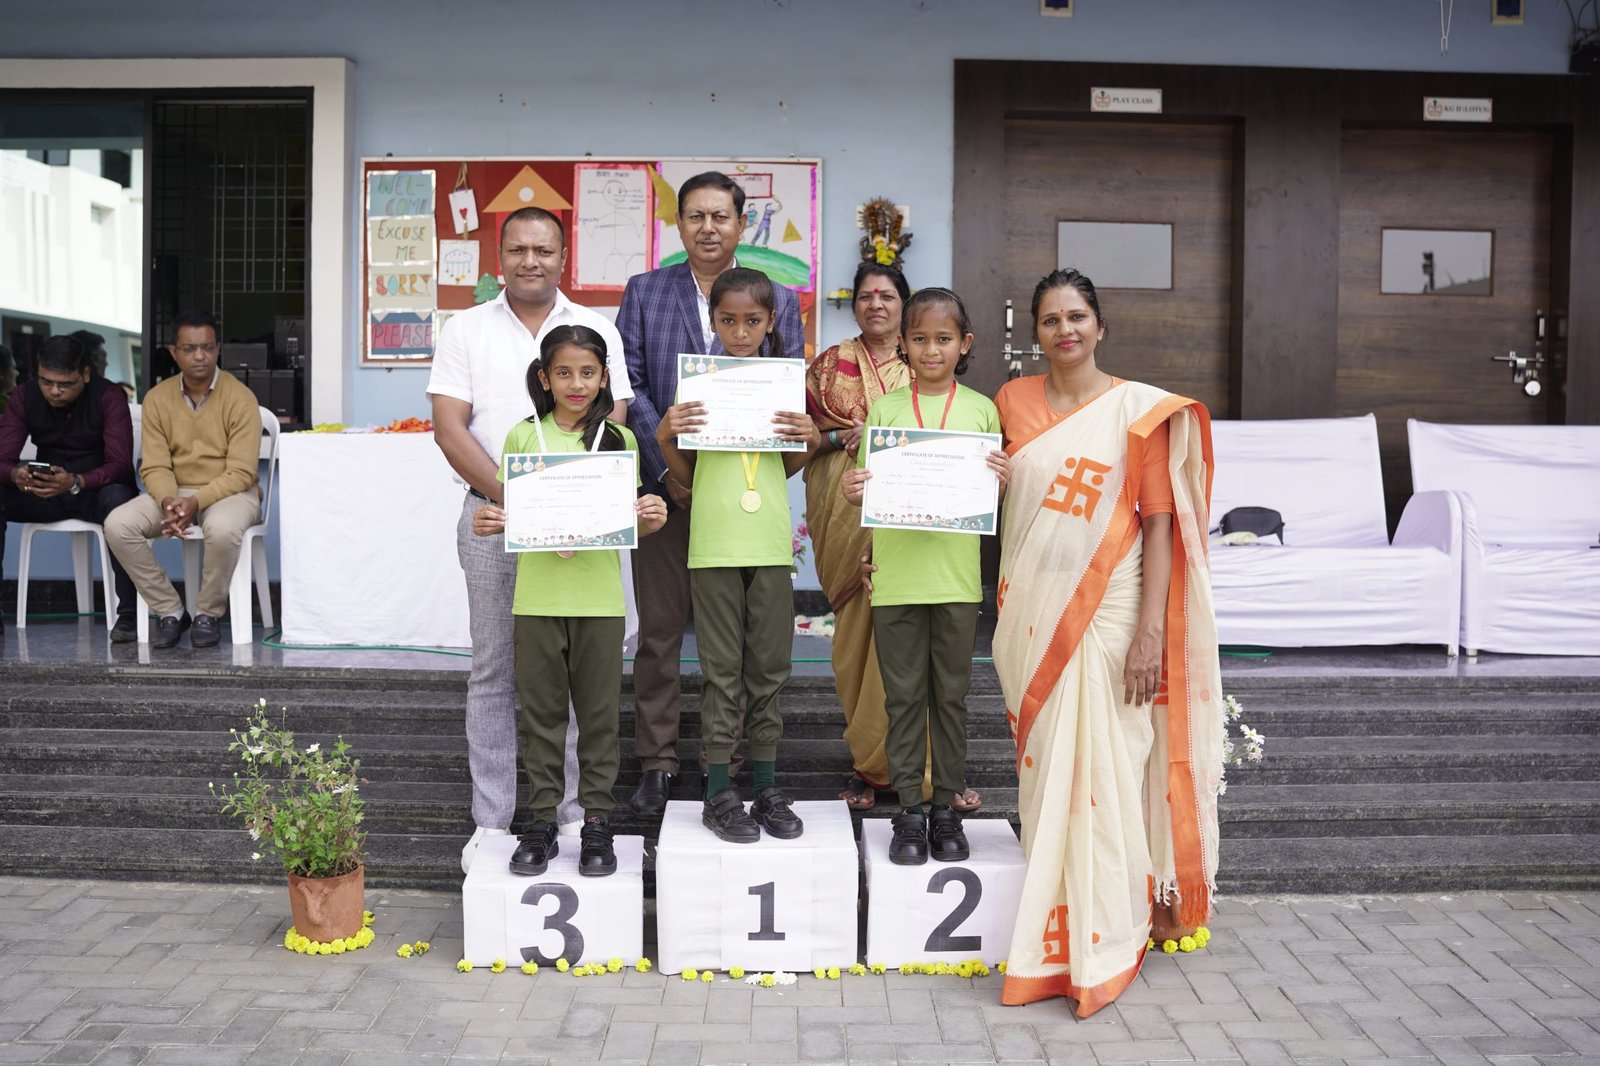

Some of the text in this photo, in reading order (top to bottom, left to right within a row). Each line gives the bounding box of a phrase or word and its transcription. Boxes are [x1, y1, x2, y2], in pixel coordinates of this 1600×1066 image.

[385, 198, 430, 216] COME
[396, 245, 417, 261] ME
[375, 274, 433, 296] SORRY
[372, 324, 433, 349] PLEASE
[934, 453, 965, 461] APPRECIATION
[747, 881, 786, 941] 1
[923, 866, 983, 953] 2
[519, 882, 585, 967] 3
